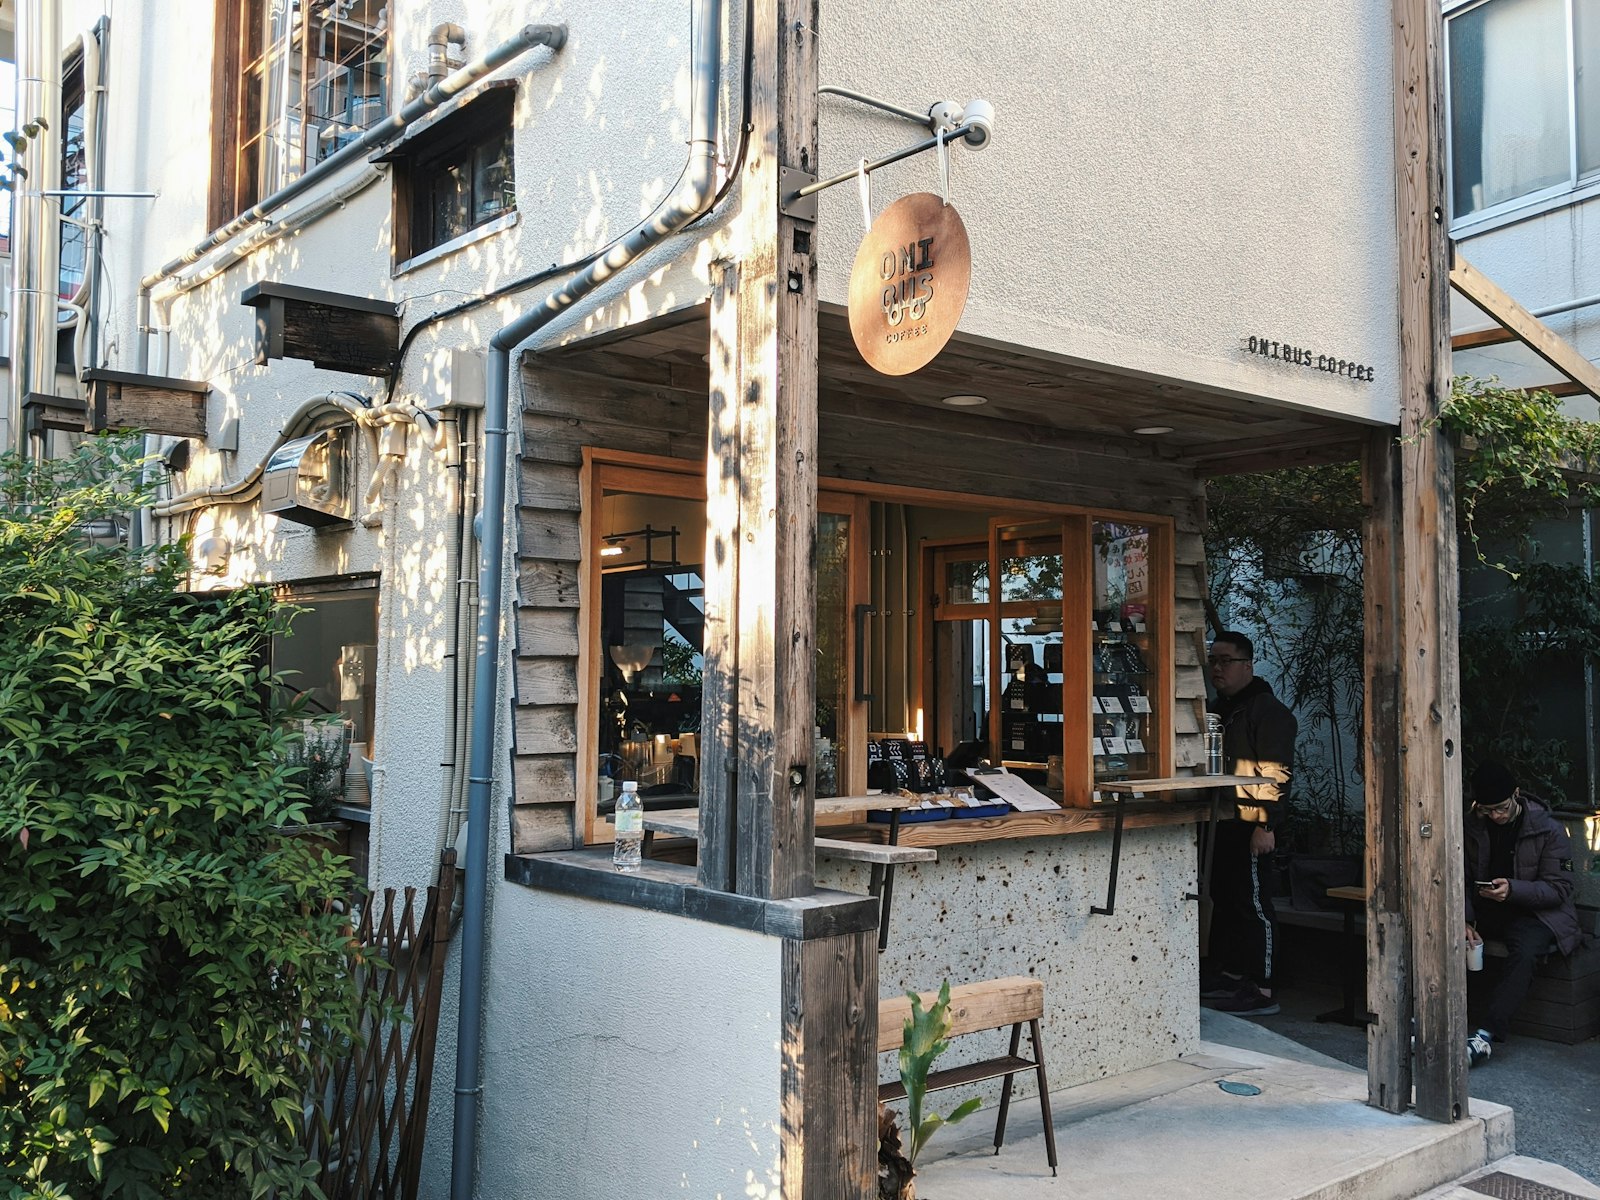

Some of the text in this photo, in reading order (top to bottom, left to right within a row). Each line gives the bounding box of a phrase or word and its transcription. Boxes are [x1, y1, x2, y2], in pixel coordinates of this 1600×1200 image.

[880, 237, 934, 280] ONI
[881, 272, 934, 324] BUS
[886, 324, 928, 344] COFFEE
[1248, 335, 1375, 383] ONIBUS COFFEE
